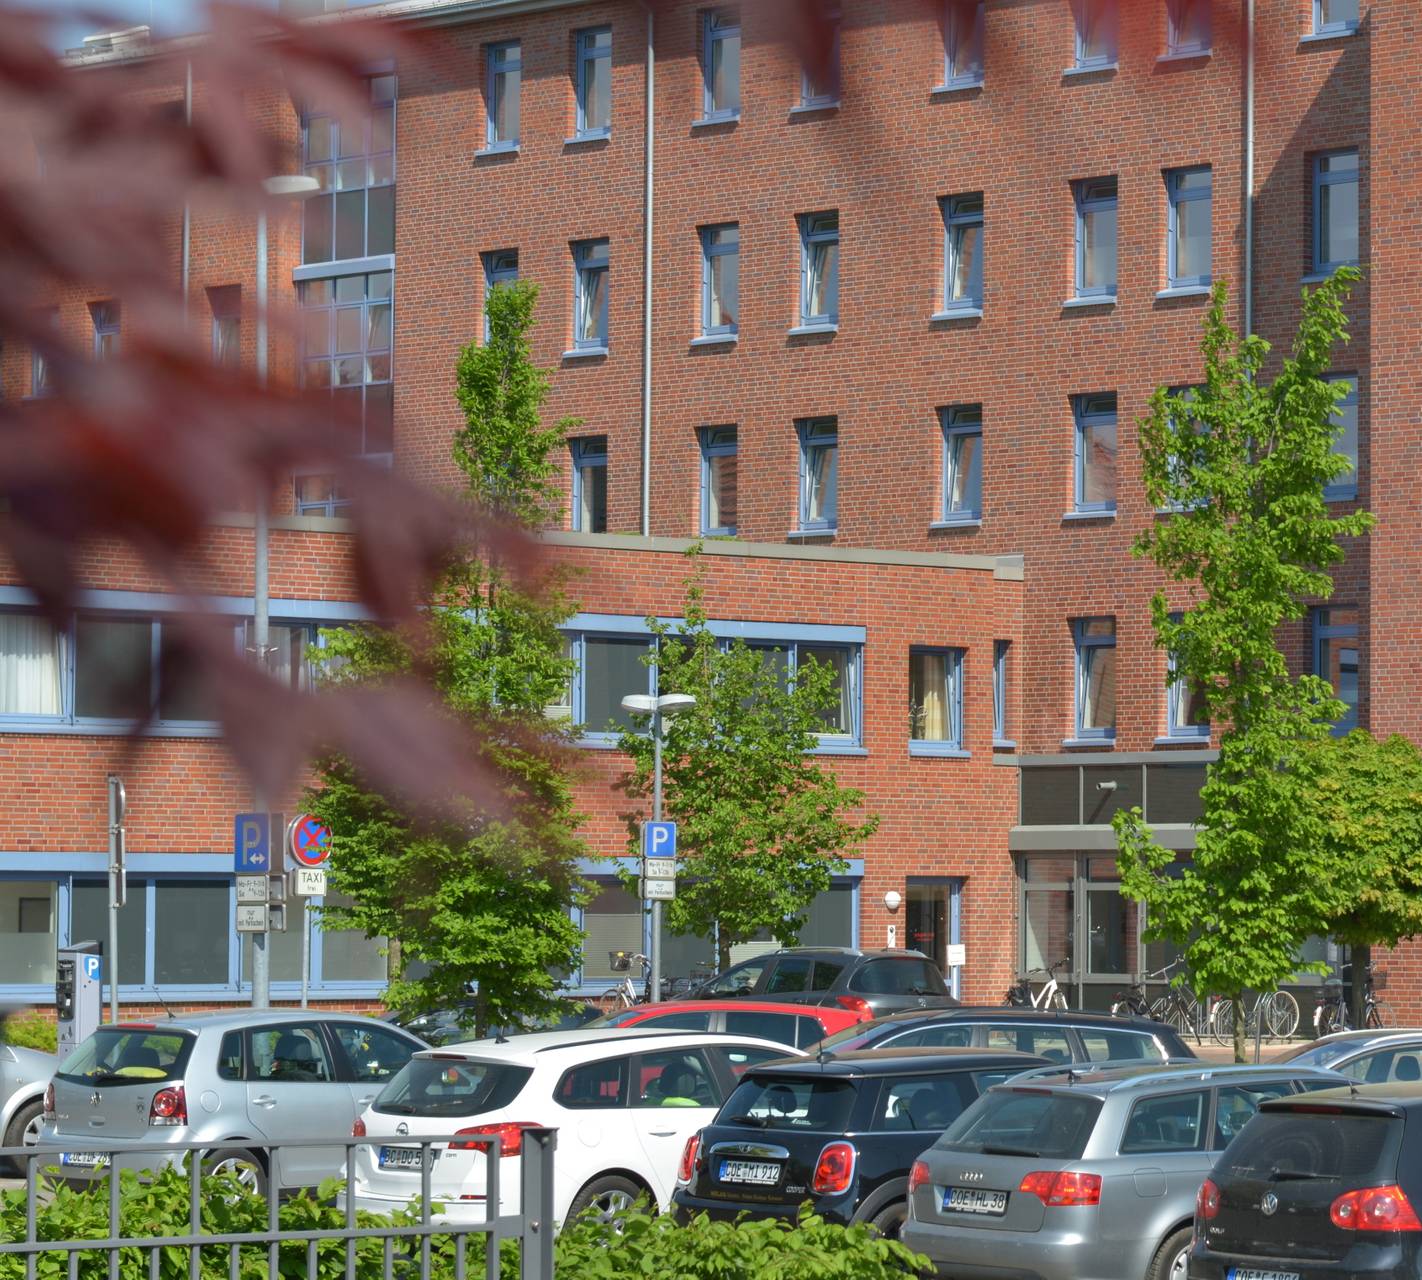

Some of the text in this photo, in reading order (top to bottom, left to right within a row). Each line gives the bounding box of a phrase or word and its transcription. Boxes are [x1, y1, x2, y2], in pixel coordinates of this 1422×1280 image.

[243, 821, 260, 865] P
[653, 826, 668, 852] P
[301, 872, 323, 883] TAXI
[88, 957, 99, 977] P
[726, 1162, 780, 1180] COE MI 912
[950, 1190, 1005, 1209] COE HL 38
